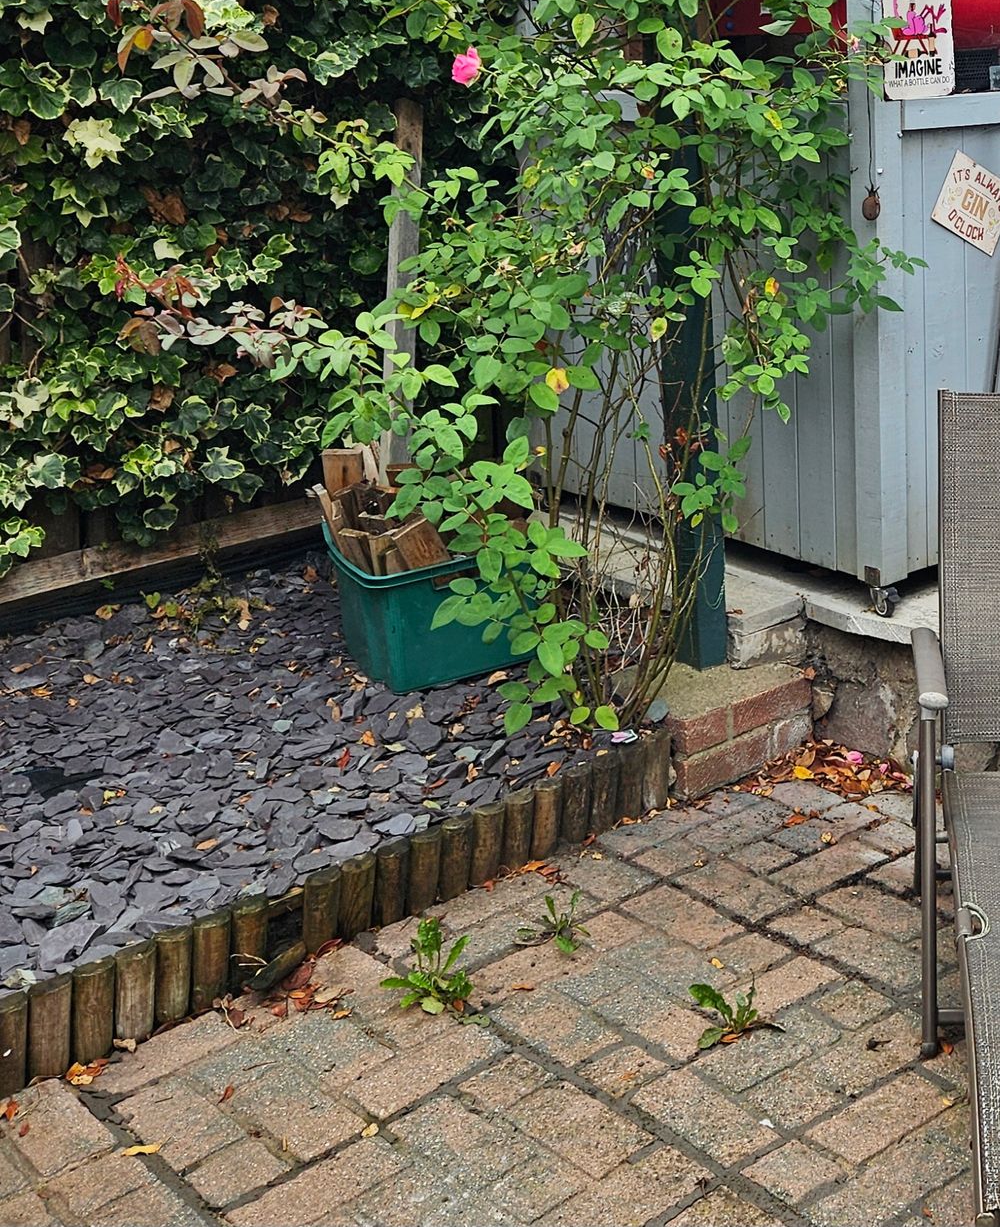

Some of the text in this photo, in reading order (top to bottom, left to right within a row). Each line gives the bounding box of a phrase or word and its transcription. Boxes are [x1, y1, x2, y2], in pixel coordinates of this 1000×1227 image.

[895, 58, 943, 79] IMAGINE
[889, 79, 903, 88] WHAT
[909, 77, 929, 86] BOTTLE
[952, 168, 970, 184] IT'S
[948, 209, 985, 241] O'CLOCK
